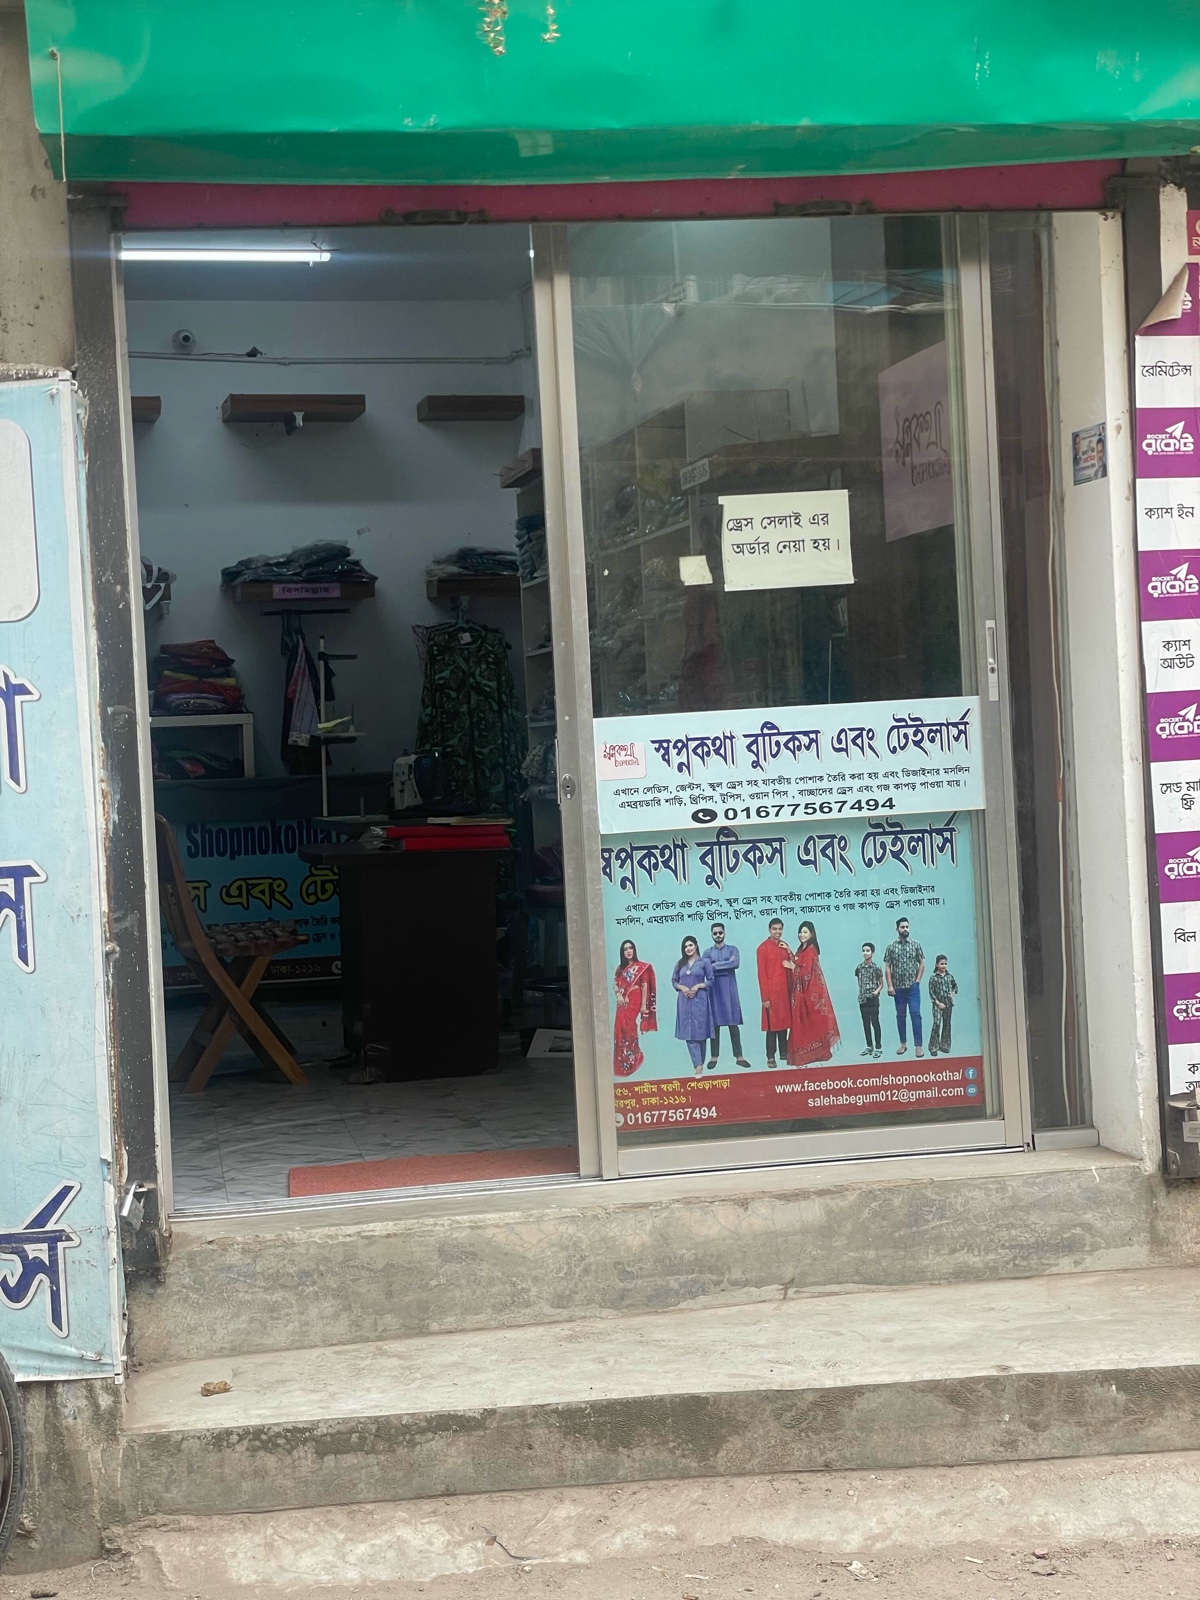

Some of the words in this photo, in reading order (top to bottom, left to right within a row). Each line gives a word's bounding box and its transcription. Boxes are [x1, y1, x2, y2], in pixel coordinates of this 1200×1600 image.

[1140, 361, 1193, 377] রেমিটেন্স
[1142, 434, 1194, 455] রকেট
[727, 517, 754, 532] ড্রেস
[761, 511, 803, 530] সেলাই
[809, 512, 829, 527] এর
[1144, 507, 1174, 519] ক্যাশ
[1177, 503, 1195, 519] ইন
[732, 537, 770, 556] অর্ডার
[777, 538, 805, 554] নেয়া
[1161, 639, 1191, 652] ক্যাশ
[1160, 653, 1196, 669] আউট
[650, 730, 736, 777] স্বপ্নকথা
[742, 721, 822, 772] বুটিকস
[831, 727, 880, 760] এবং
[887, 708, 971, 758] টেইলার্স
[613, 787, 639, 797] এখানে
[707, 782, 723, 791] স্কুল
[726, 781, 744, 791] ড্রেস
[746, 780, 760, 789] সহ
[762, 775, 791, 787] যাবতীয়
[795, 776, 824, 785] পোশাক
[827, 772, 846, 783] তৈরি
[848, 773, 865, 782] করা
[867, 772, 879, 780] হয়
[882, 771, 899, 780] এবং
[901, 767, 940, 778] ডিজাইনার
[943, 765, 970, 776] মসলিন
[748, 791, 770, 801] ওয়ান
[836, 785, 854, 796] ড্রেস
[856, 784, 875, 793] এবং
[876, 783, 891, 792] গজ
[893, 782, 917, 791] কাপড়
[919, 780, 944, 790] পাওয়া
[1159, 782, 1183, 795] সেন্ড
[723, 797, 896, 821] 01677567494
[1180, 793, 1196, 811] ফ্রি
[694, 826, 787, 890] বুটিকস
[797, 833, 854, 874] এবং
[861, 811, 958, 873] টেইলার্স
[221, 877, 293, 910] এবং
[625, 903, 649, 912] এখানে
[651, 899, 676, 910] লেডিস
[741, 896, 758, 906] ড্রেস
[760, 895, 773, 904] সহ
[775, 891, 802, 903] যাবতীয়
[804, 892, 832, 901] পোশাক
[834, 888, 851, 899] তৈরি
[853, 890, 868, 898] করা
[870, 889, 881, 897] হয়
[883, 888, 899, 896] এবং
[900, 885, 935, 895] ডিজাইনার
[687, 910, 704, 922] শাড়ি
[843, 902, 856, 911] গজ
[858, 901, 880, 911] কাপড়
[903, 899, 925, 908] পাওয়া
[1173, 927, 1197, 943] বিল
[633, 1082, 658, 1094] শামীম
[774, 1068, 963, 1093] www.facebook.com/shopnookotha/
[808, 1085, 965, 1107] salehabegum012@gmail.com
[626, 1106, 718, 1125] 01677567494
